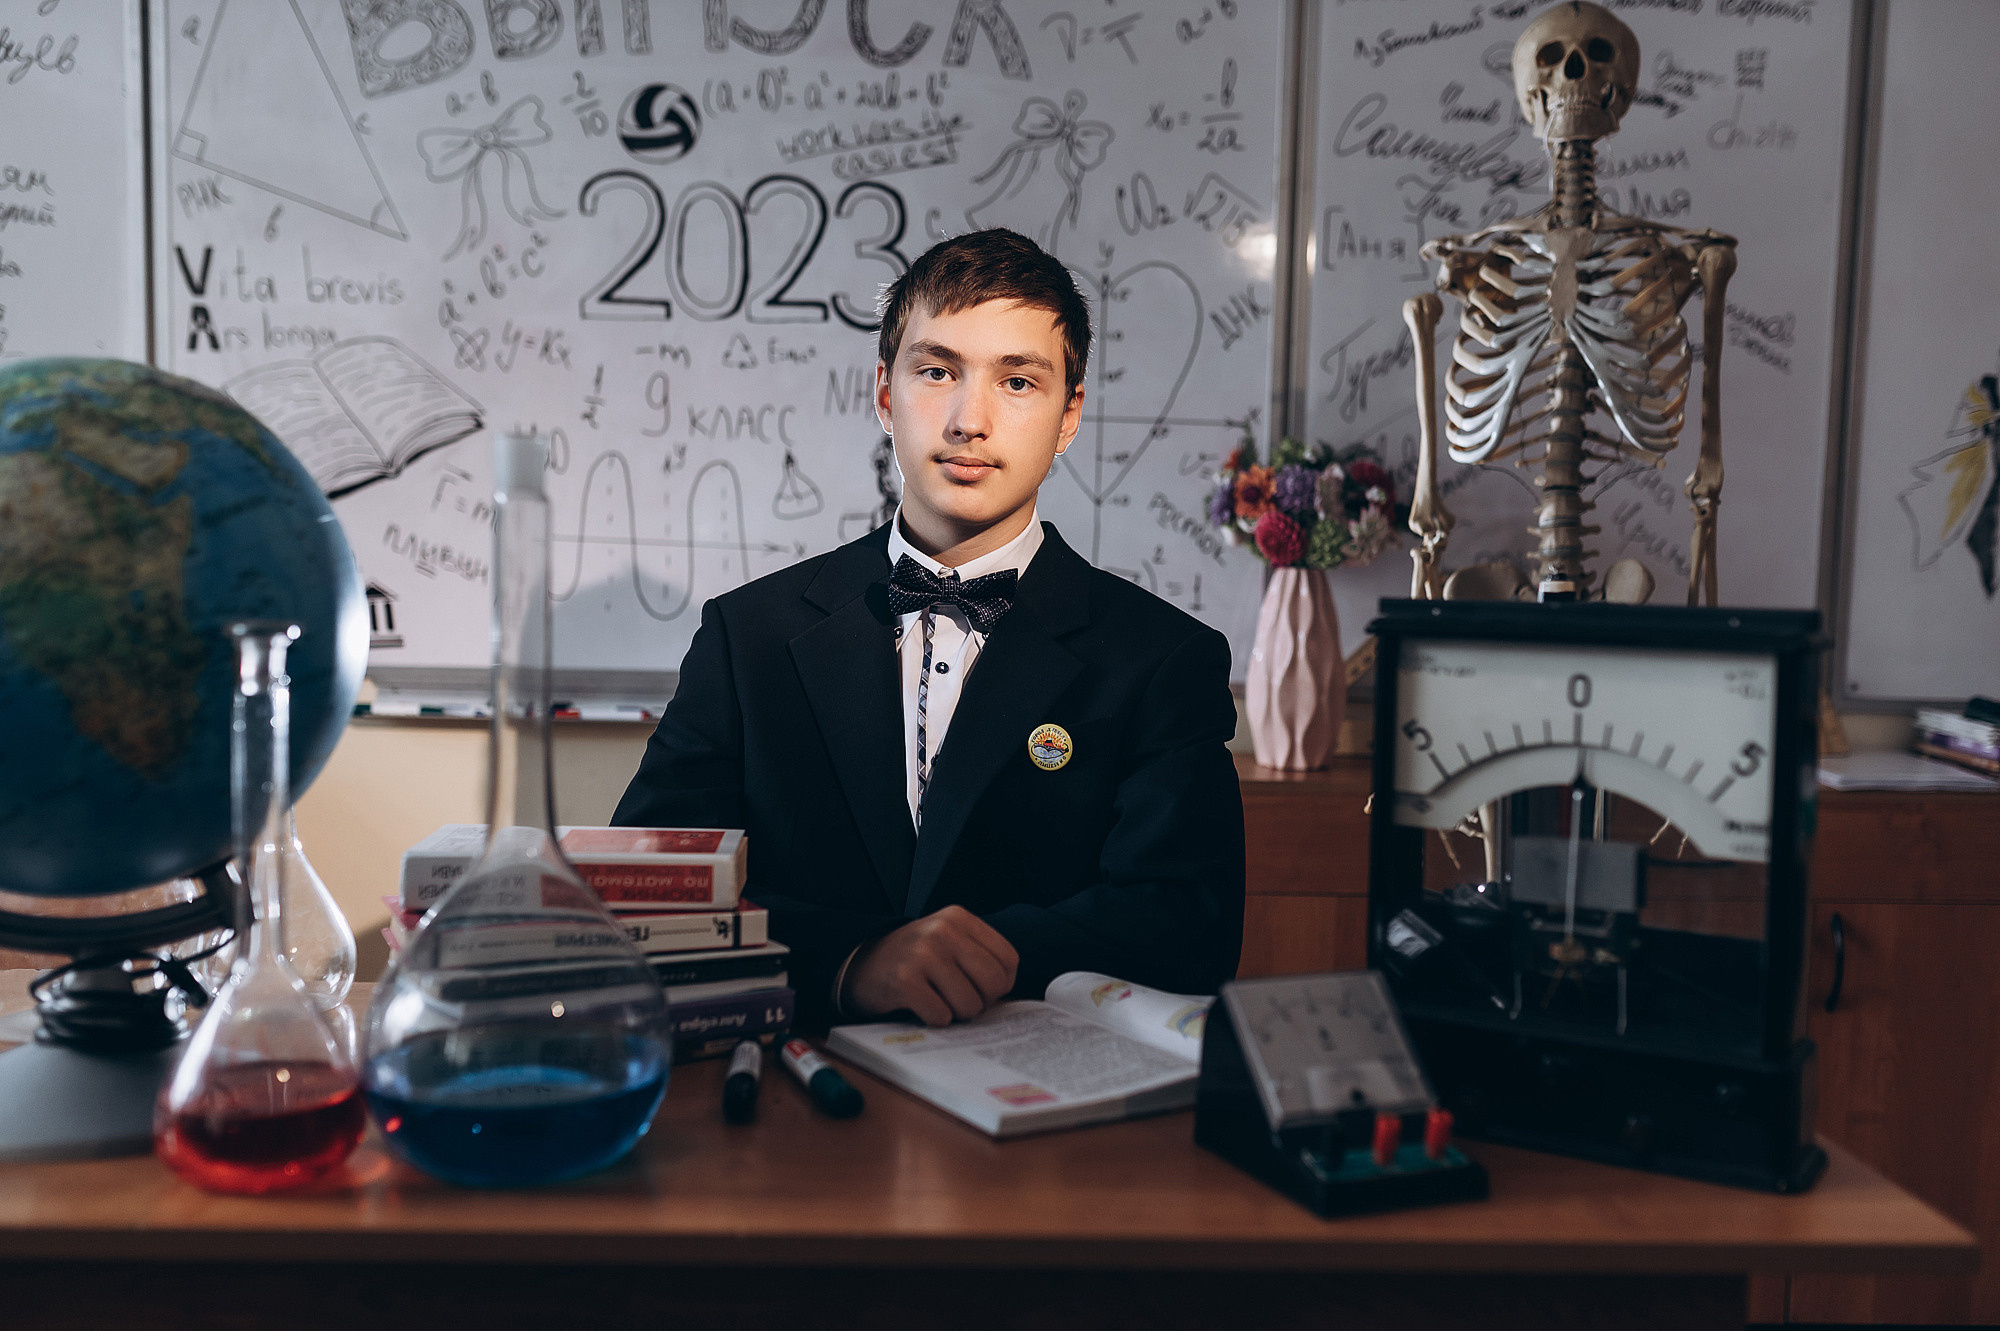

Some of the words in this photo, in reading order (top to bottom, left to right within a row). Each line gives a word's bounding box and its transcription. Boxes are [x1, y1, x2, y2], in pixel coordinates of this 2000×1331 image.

[175, 245, 279, 302] Vita
[303, 245, 404, 302] brevis
[578, 168, 914, 333] 2023
[1402, 718, 1433, 753] 5
[1566, 671, 1593, 709] 0
[1729, 739, 1767, 779] 5
[679, 1013, 747, 1033] Алгебра
[763, 1005, 786, 1025] 11
